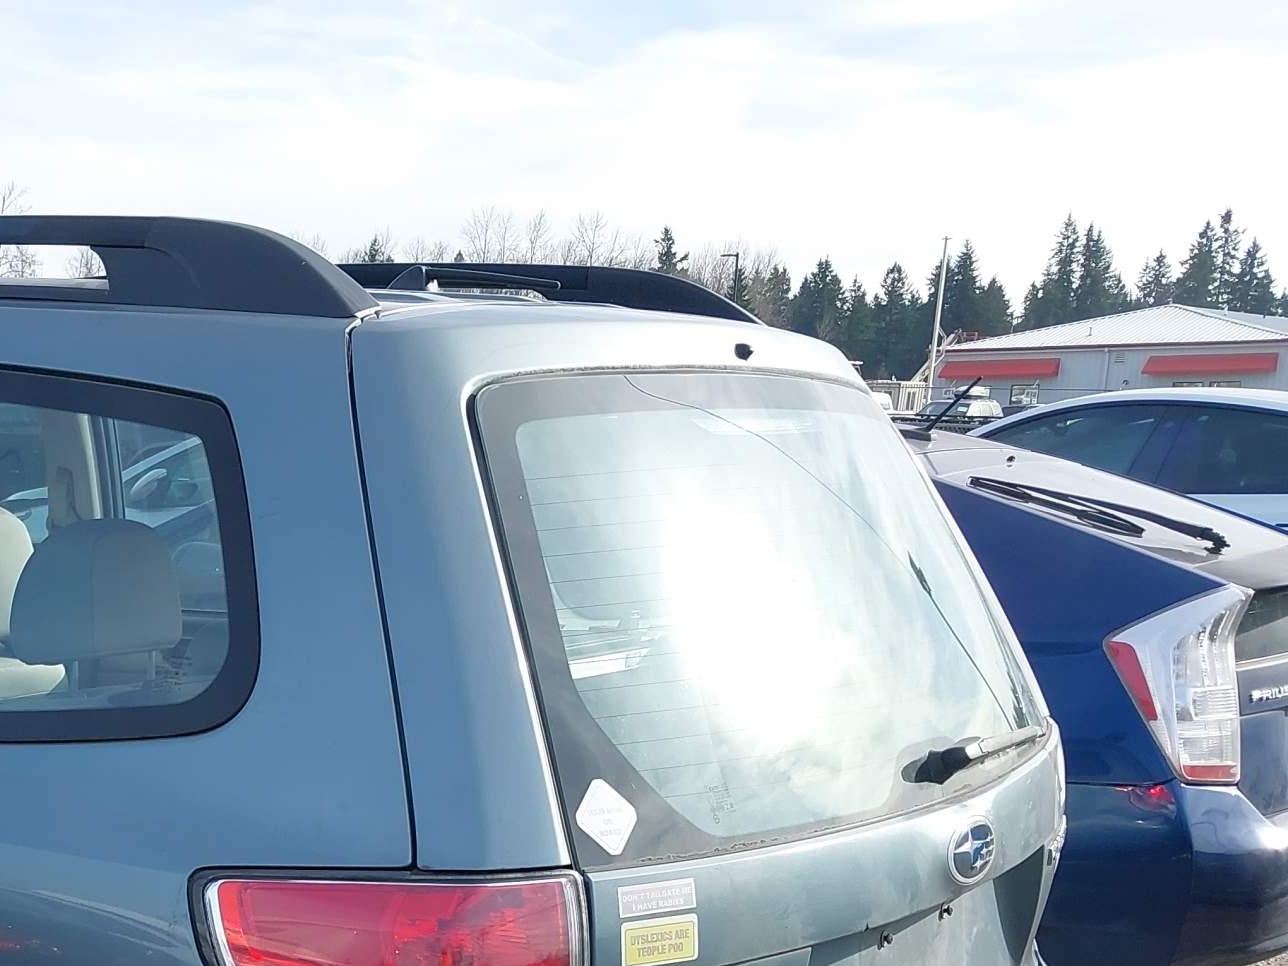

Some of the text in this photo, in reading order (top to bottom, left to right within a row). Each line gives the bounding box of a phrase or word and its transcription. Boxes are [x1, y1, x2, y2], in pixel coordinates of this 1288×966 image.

[637, 901, 657, 912] HAVE
[631, 928, 690, 945] DYSLEXICS ARE
[668, 942, 684, 953] POO
